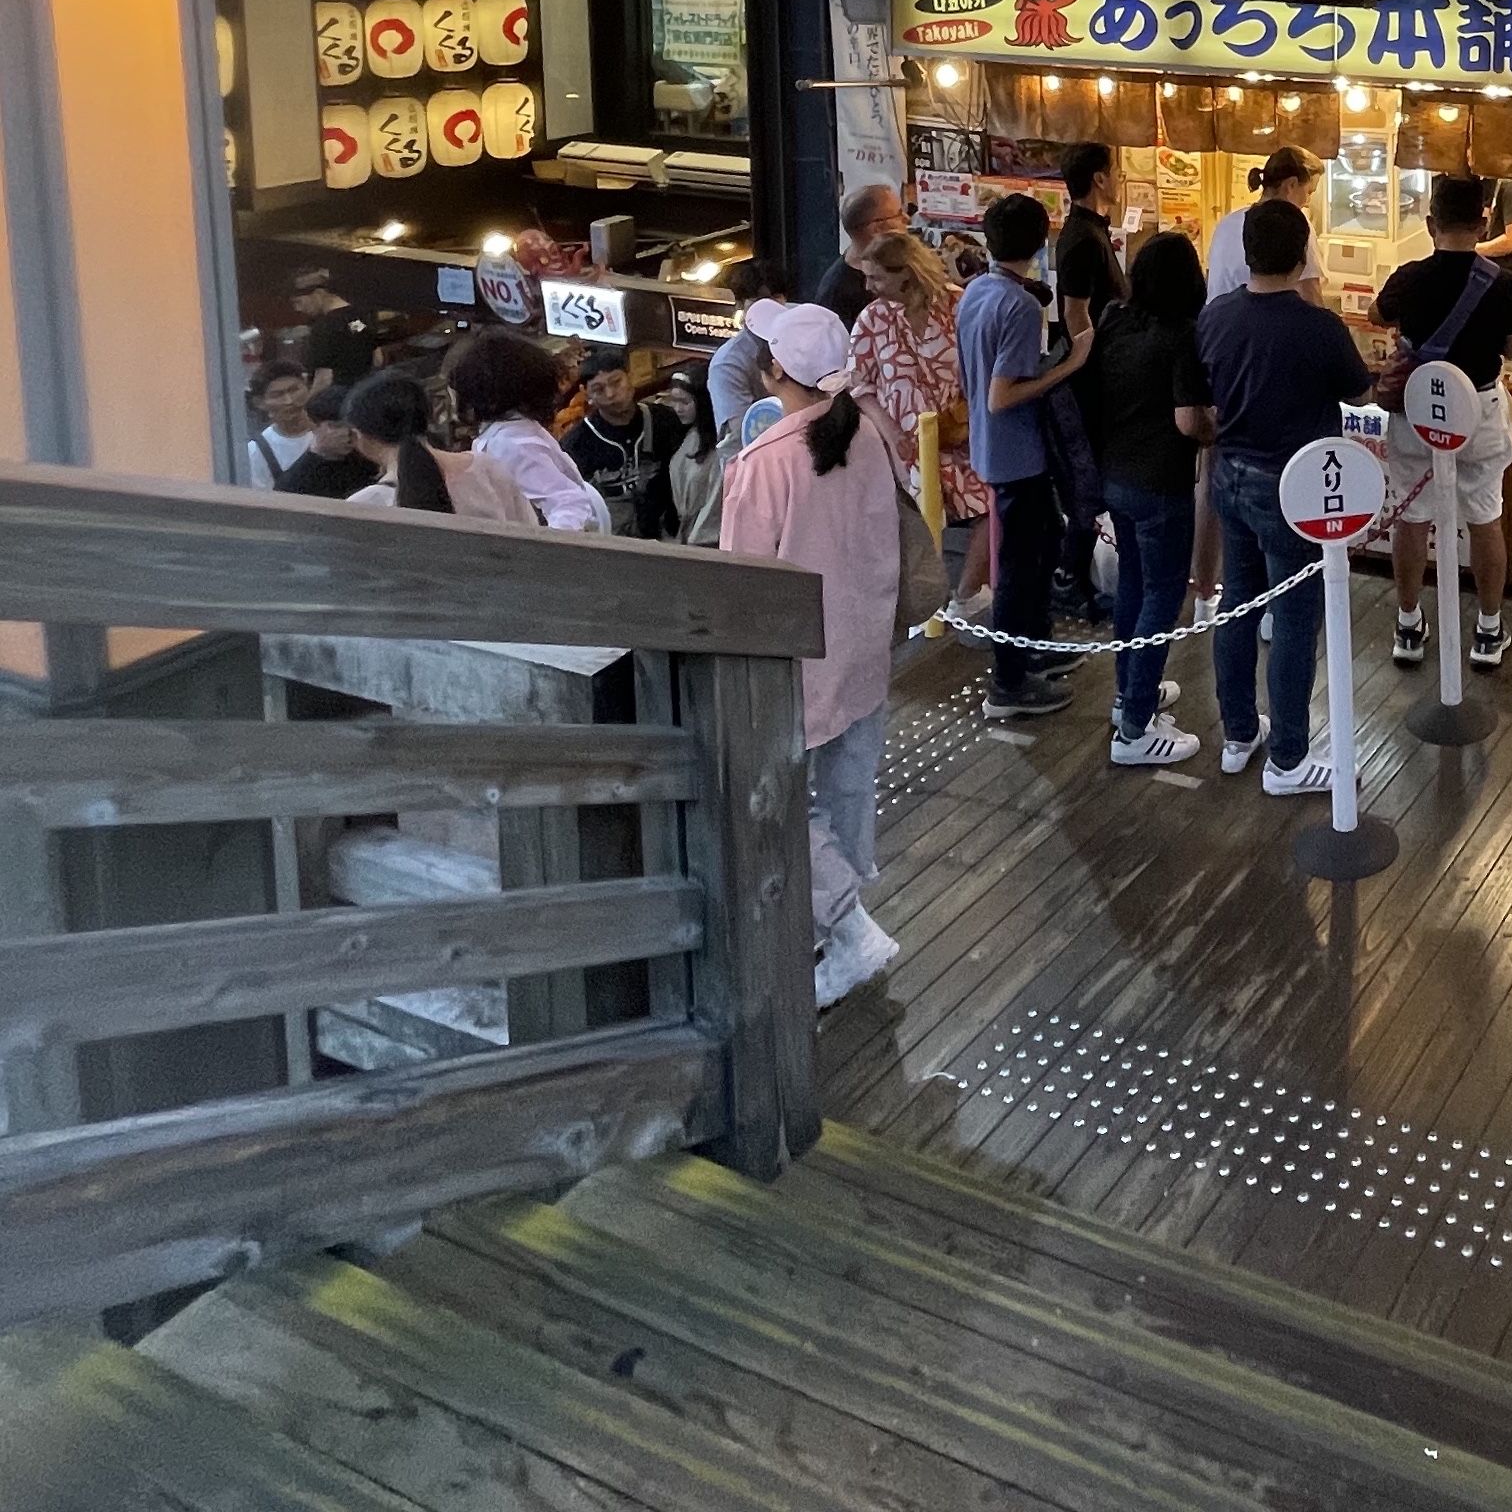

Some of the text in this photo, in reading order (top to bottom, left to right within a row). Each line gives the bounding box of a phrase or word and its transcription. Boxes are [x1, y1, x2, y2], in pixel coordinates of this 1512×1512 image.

[916, 21, 980, 44] Takoyaki
[1431, 378, 1446, 422] 出口
[1428, 430, 1452, 446] OUT
[1322, 450, 1344, 515] 入り口
[1326, 519, 1343, 533] IN
